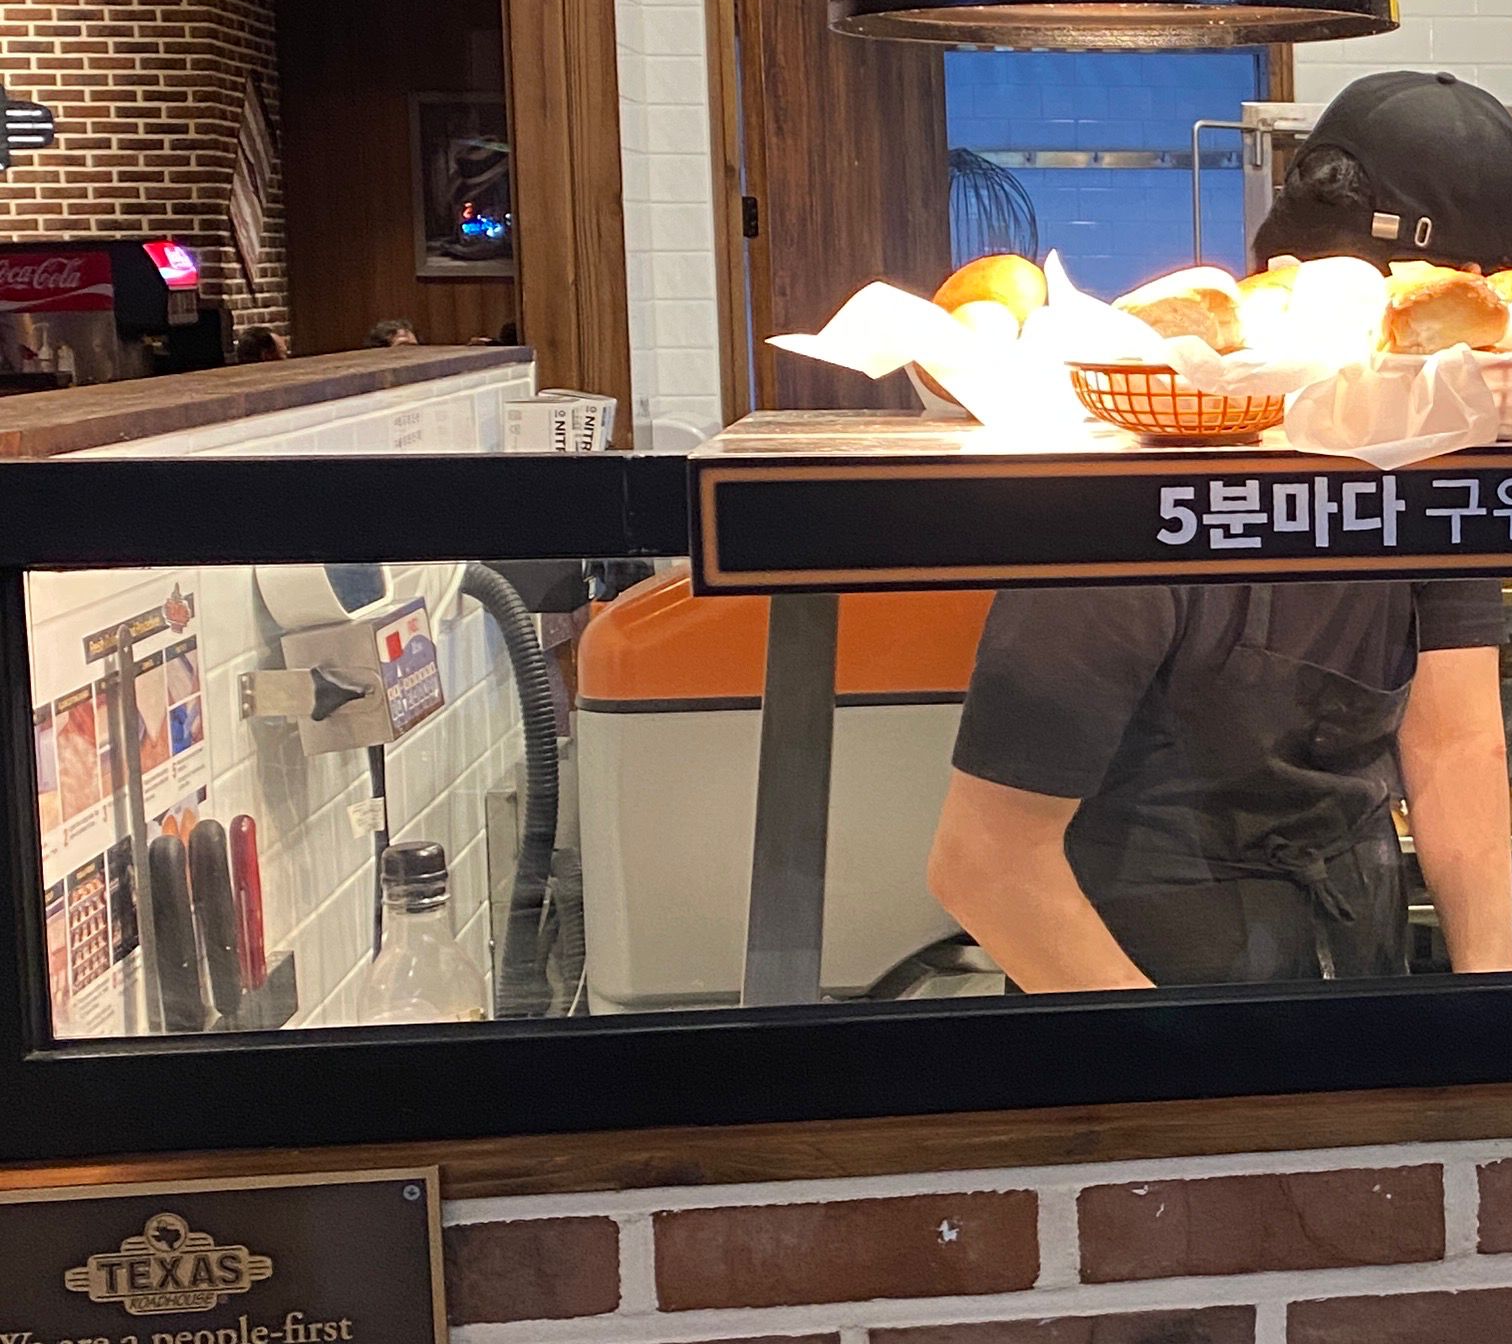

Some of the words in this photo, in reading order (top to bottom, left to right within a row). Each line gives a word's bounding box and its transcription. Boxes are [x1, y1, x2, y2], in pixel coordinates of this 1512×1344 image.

[0, 257, 84, 289] oca-Cola
[1156, 475, 1406, 549] 5분마다
[97, 1253, 243, 1294] TEXAS
[130, 1292, 214, 1309] ROADHOUSE
